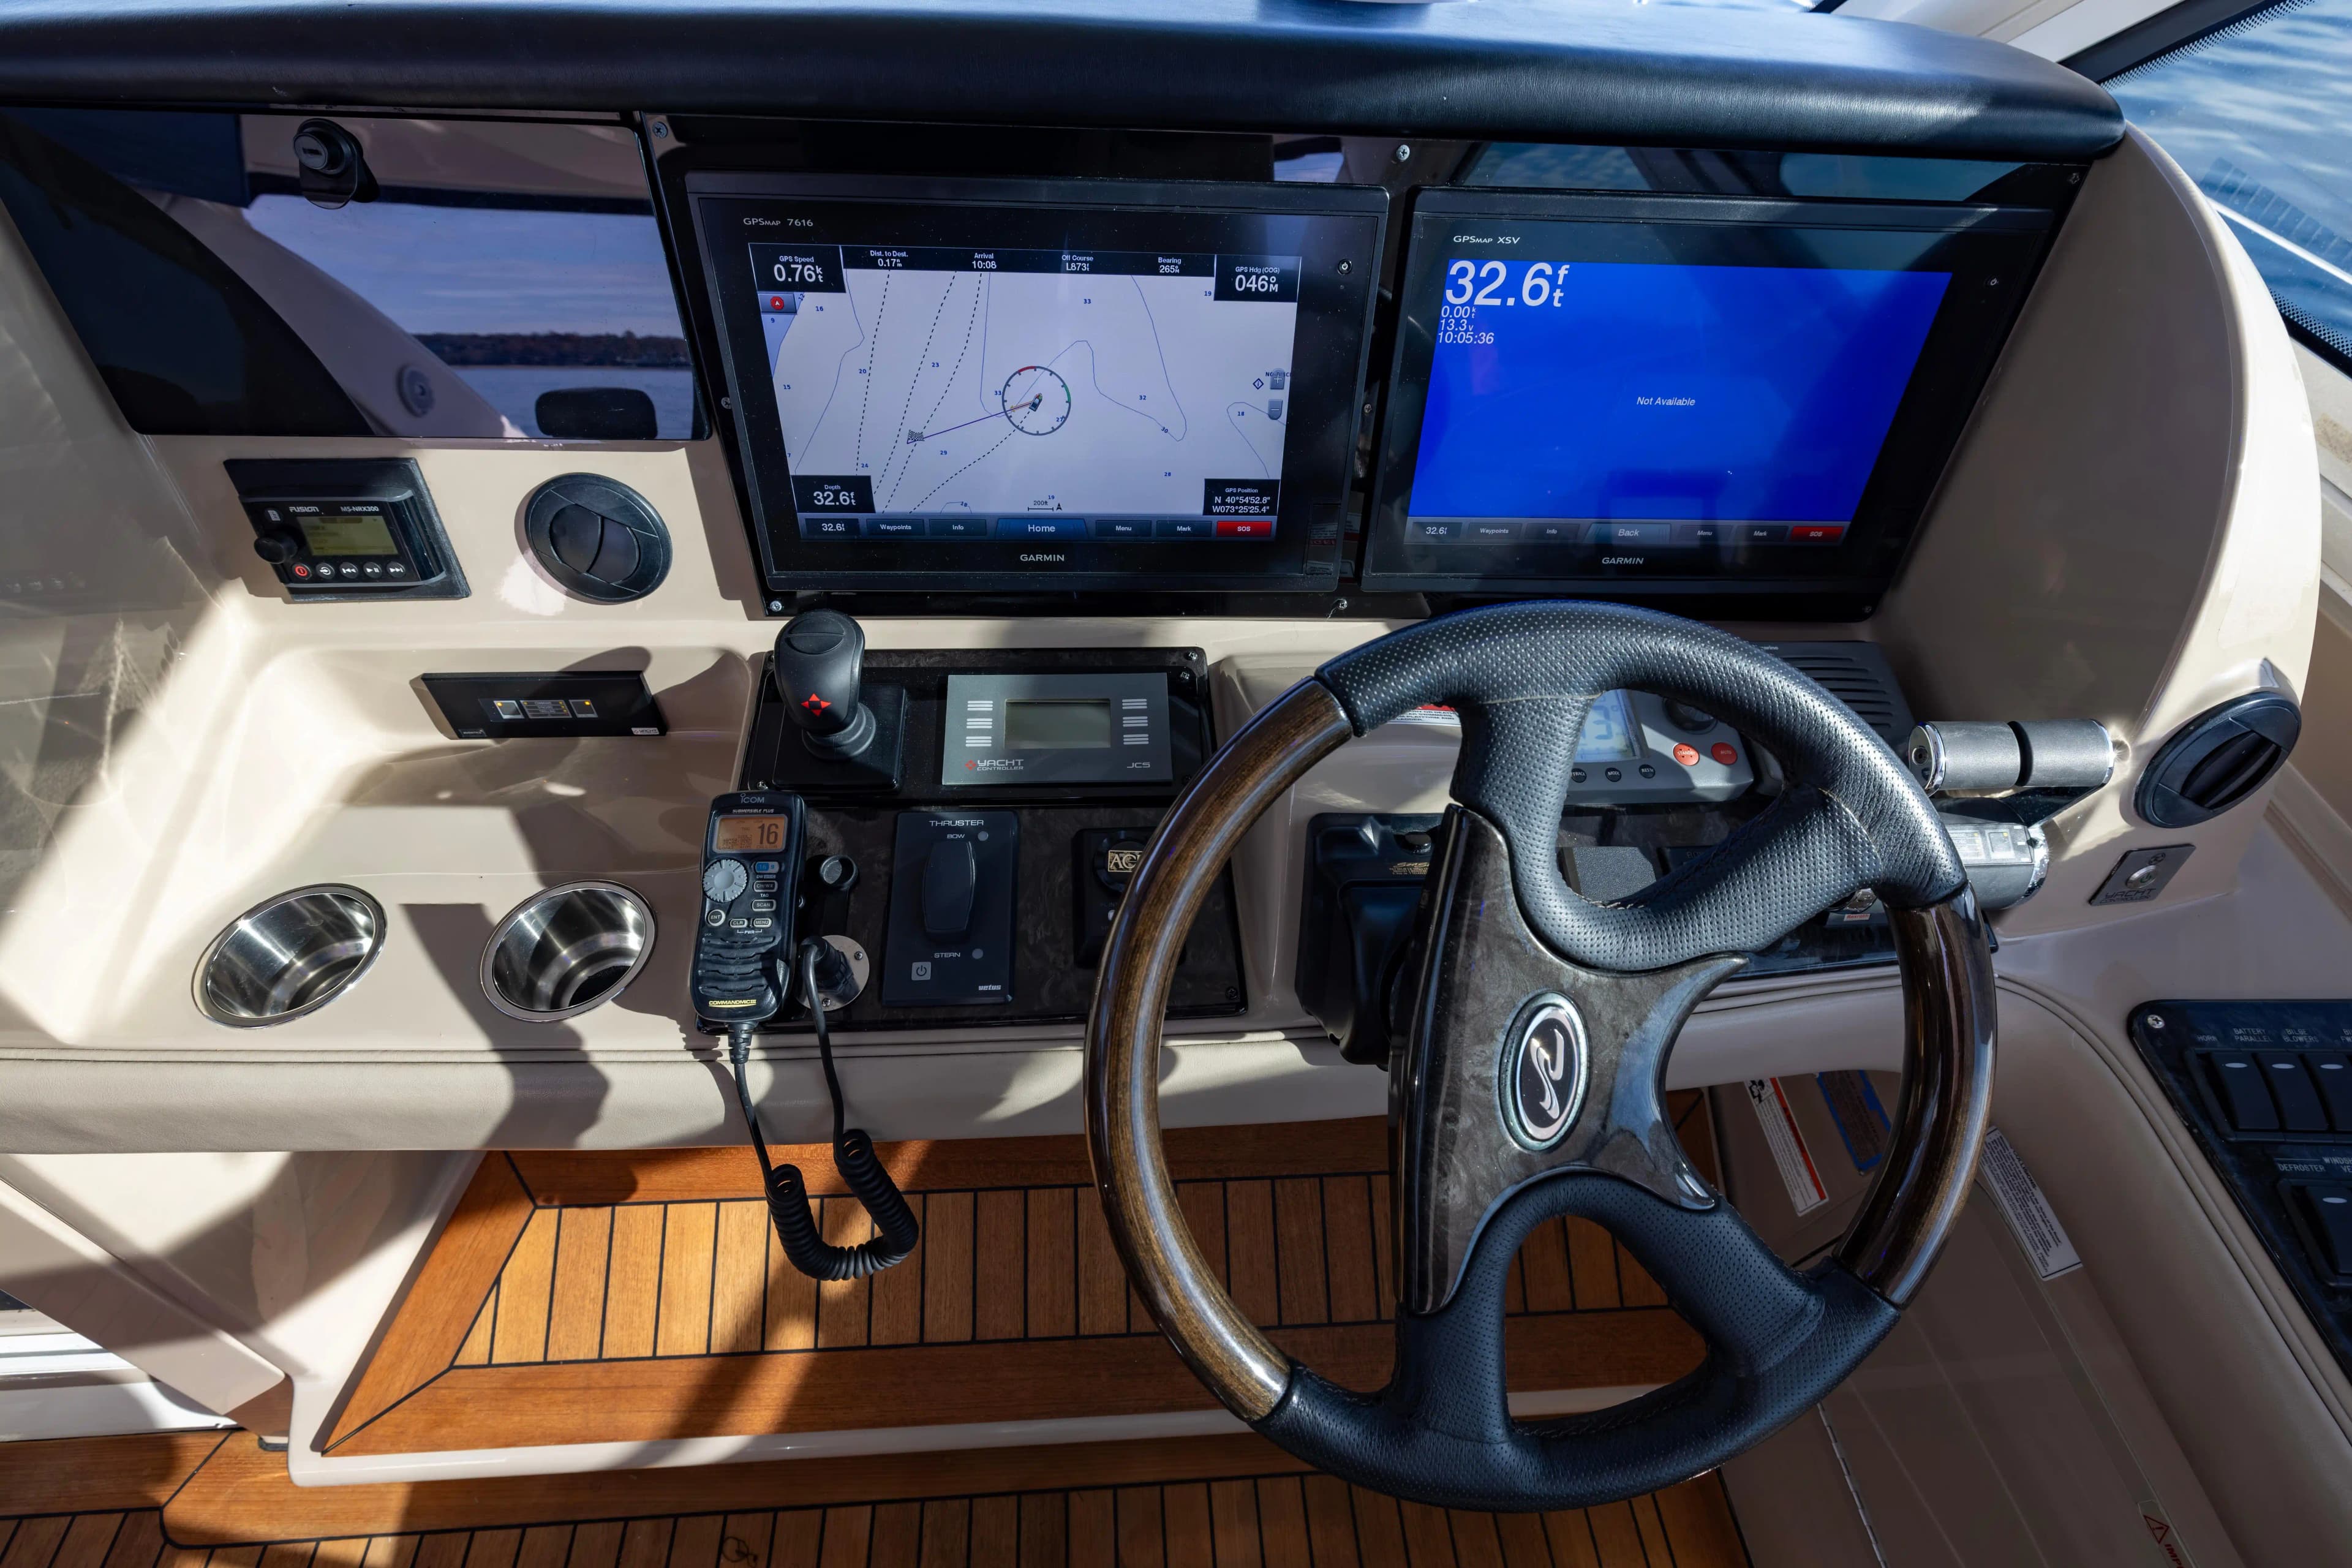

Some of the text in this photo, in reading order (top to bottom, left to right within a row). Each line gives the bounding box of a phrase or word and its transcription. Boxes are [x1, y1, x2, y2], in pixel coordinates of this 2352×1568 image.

[743, 217, 781, 226] GPSMAP
[1453, 235, 1520, 244] GPSMAP XSV
[971, 260, 997, 270] 10:08
[1438, 331, 1494, 345] 10:05:36
[1637, 396, 1696, 406] Not Available
[1028, 524, 1056, 533] Home
[1618, 528, 1639, 537] Back
[1020, 554, 1065, 562] GARMIN
[1601, 556, 1644, 565] GARMIN
[758, 823, 779, 845] 16
[1109, 853, 1140, 869] AC
[2105, 888, 2156, 899] YACHT
[2278, 1164, 2326, 1172] DEFROSTER
